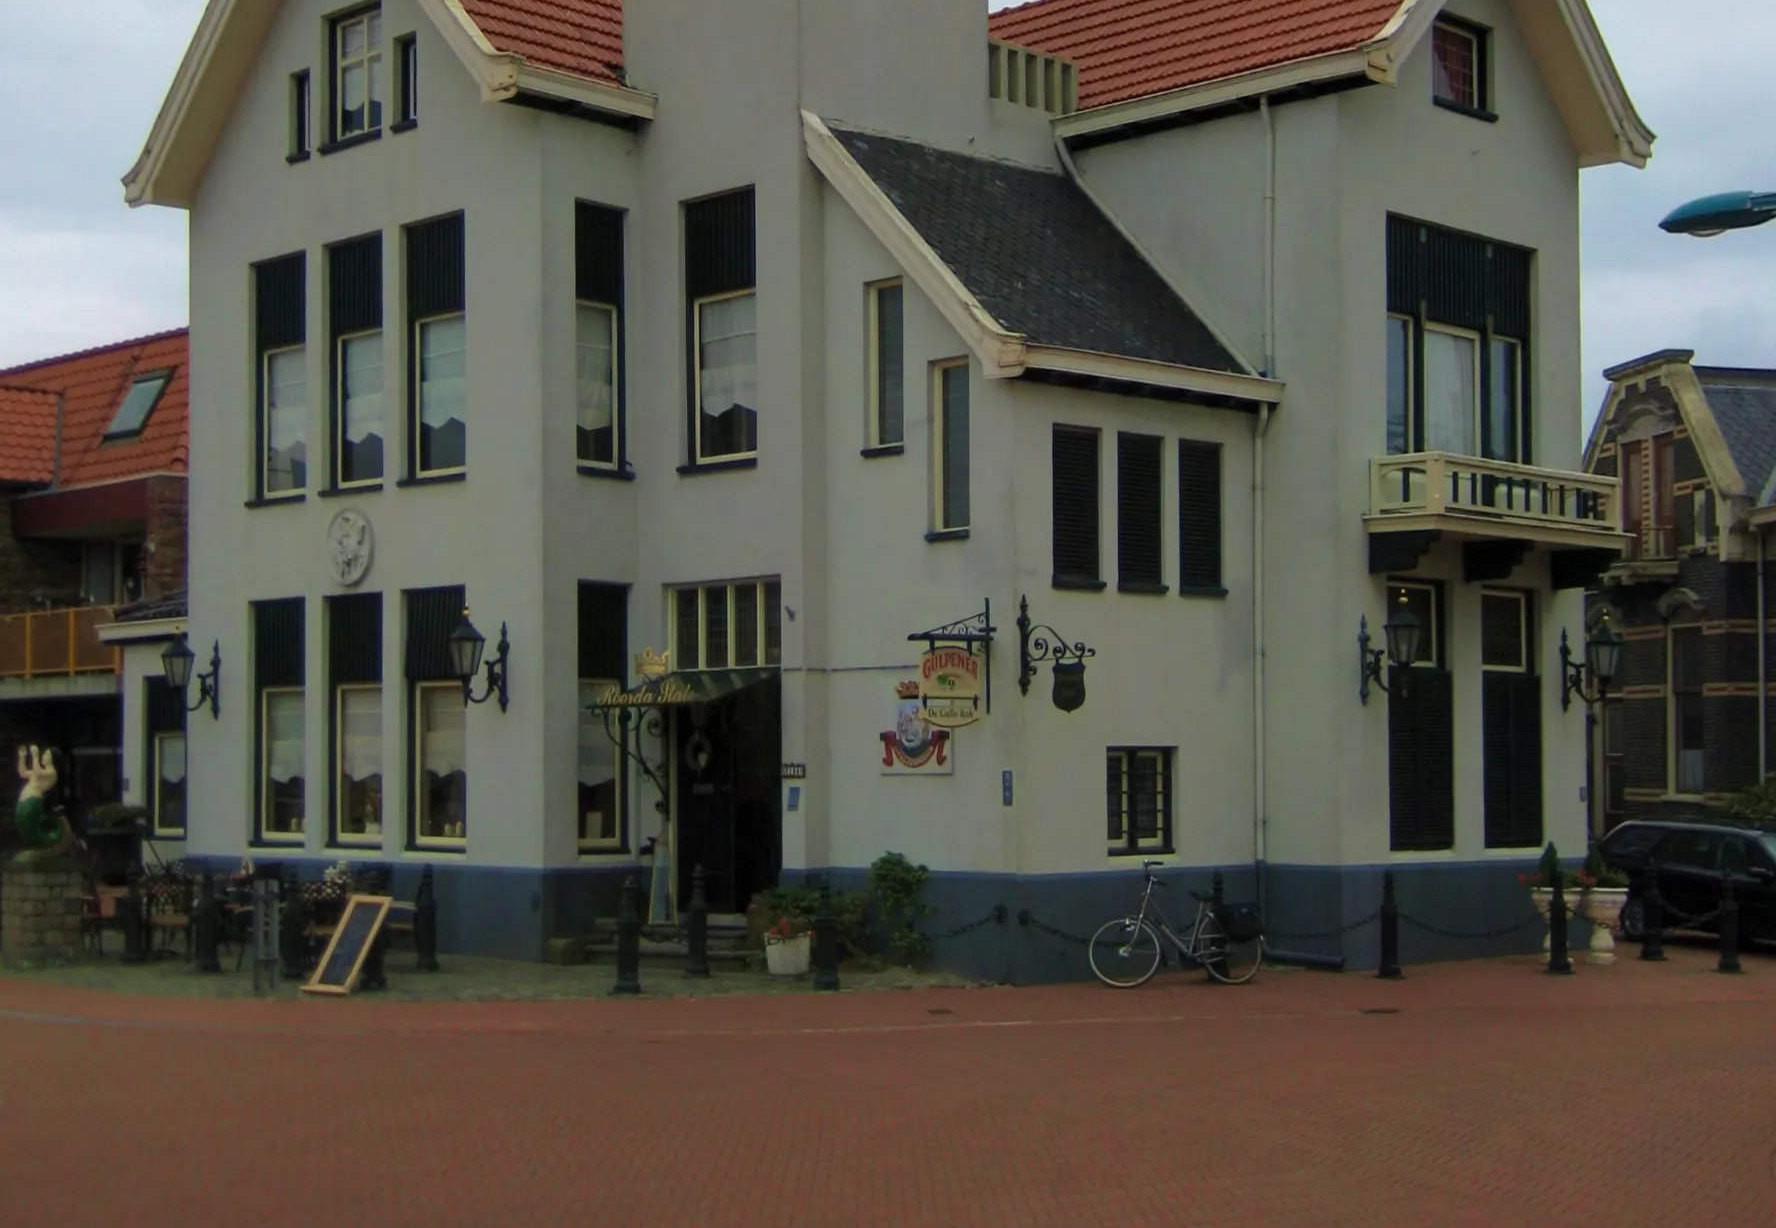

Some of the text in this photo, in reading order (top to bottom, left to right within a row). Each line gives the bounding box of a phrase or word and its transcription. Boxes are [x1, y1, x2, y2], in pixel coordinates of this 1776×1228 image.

[922, 652, 978, 681] GULPENER
[597, 684, 655, 705] Roorda
[928, 708, 937, 718] De
